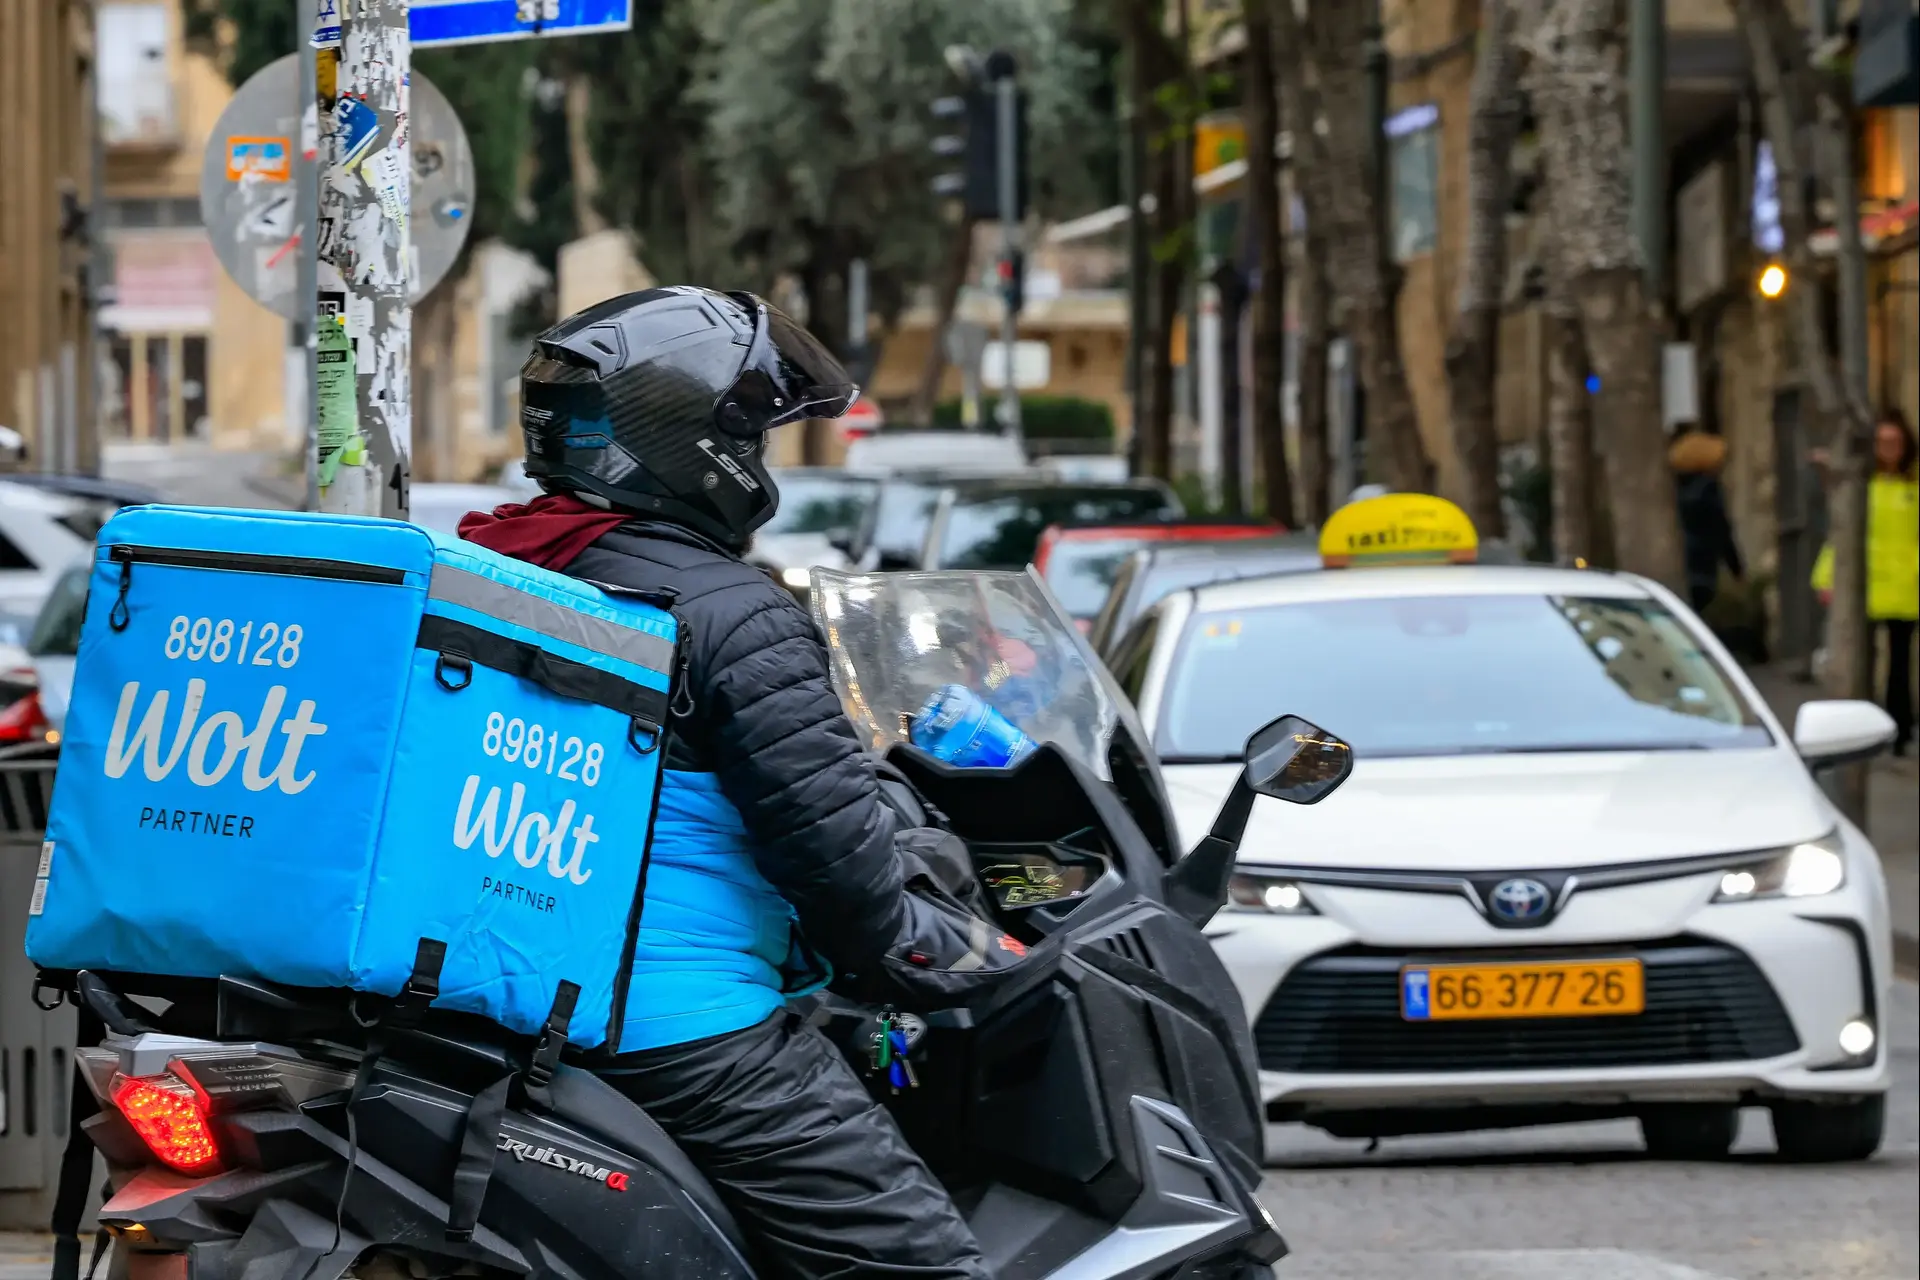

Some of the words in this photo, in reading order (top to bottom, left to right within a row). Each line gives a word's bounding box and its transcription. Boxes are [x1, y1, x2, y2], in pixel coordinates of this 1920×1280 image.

[696, 438, 760, 492] LS2
[165, 615, 303, 668] 898128
[104, 678, 328, 794] Wolt
[482, 711, 604, 787] 898128
[139, 807, 254, 838] PARTNER
[453, 775, 599, 885] Wolt
[482, 876, 556, 914] PARTNER
